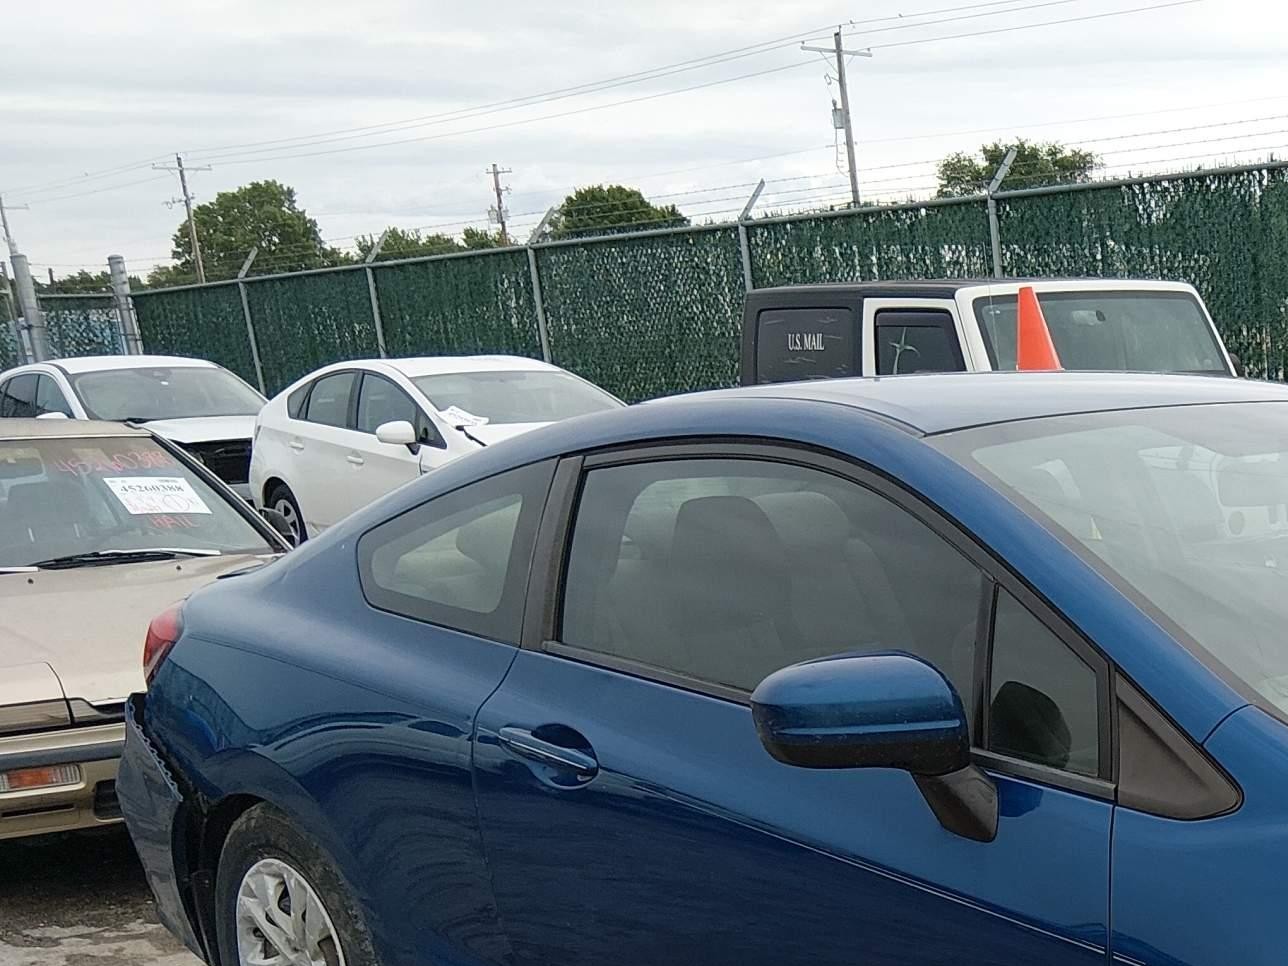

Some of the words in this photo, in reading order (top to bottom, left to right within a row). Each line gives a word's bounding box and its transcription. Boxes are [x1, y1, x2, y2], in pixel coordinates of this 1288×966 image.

[788, 333, 802, 350] U.S.
[803, 333, 825, 350] MAIL
[120, 485, 184, 493] 45260388
